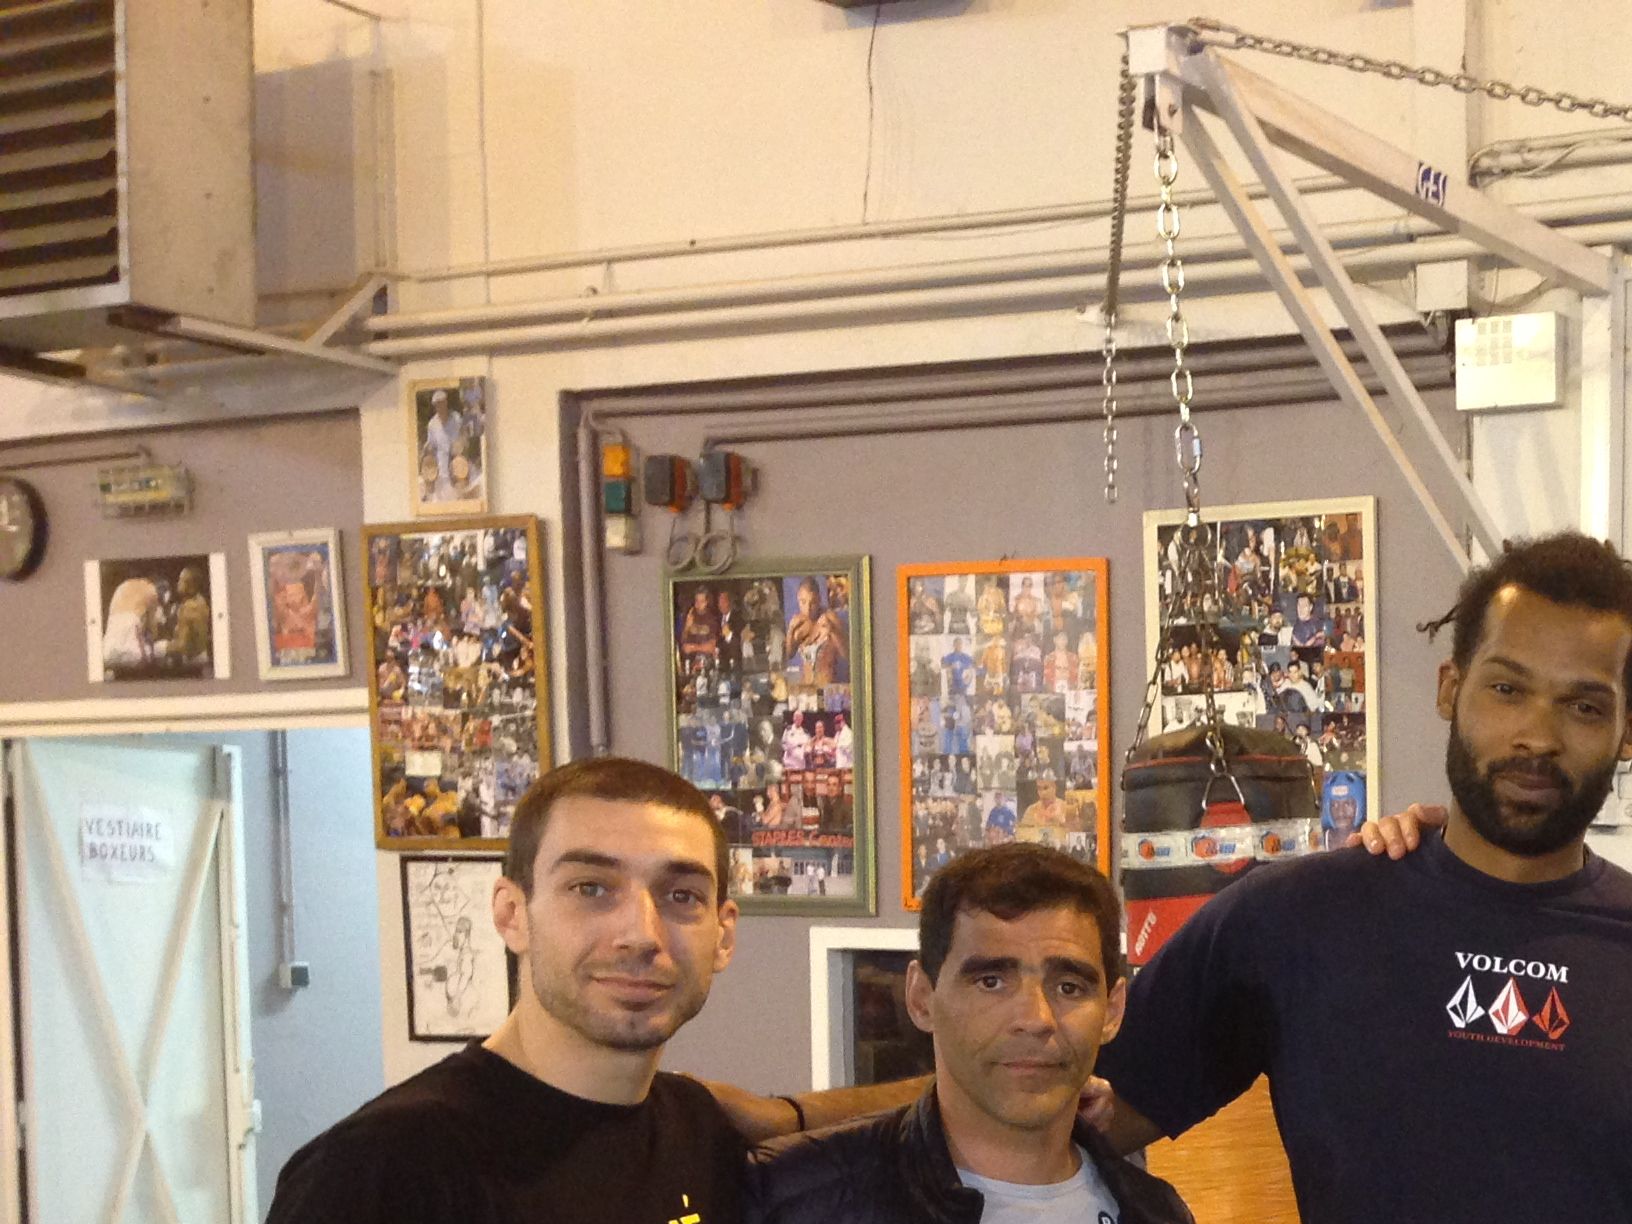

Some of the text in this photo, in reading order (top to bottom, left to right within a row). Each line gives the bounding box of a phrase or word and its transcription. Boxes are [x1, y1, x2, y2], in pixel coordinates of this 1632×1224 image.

[86, 817, 162, 839] VESTIAIRE
[751, 830, 804, 847] STAPLES
[88, 842, 155, 863] BOXEURS
[1454, 951, 1570, 984] VOLCOM
[1448, 1030, 1566, 1051] YOUTH DEVELOPMENT
